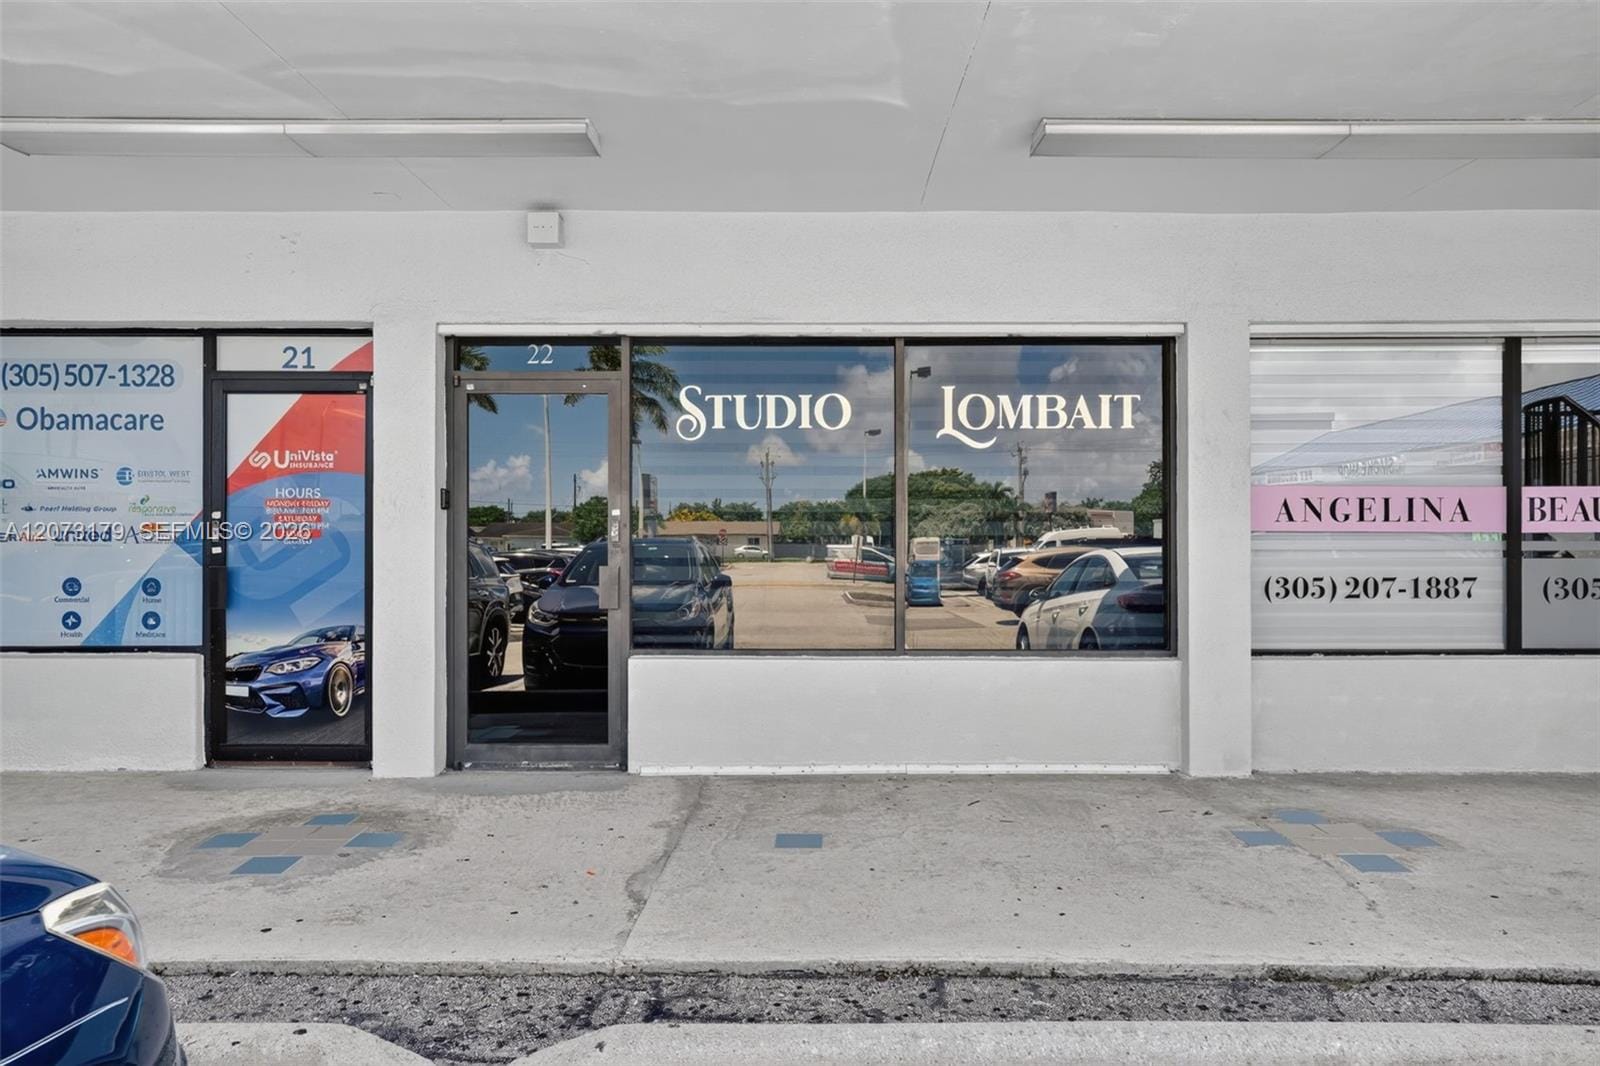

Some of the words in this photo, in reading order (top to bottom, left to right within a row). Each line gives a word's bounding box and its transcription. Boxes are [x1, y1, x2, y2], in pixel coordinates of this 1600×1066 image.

[281, 346, 315, 369] 21
[526, 344, 554, 365] 22
[1, 362, 60, 391] (305)
[64, 363, 175, 388] 507-1328
[16, 407, 165, 432] Obamacare
[273, 450, 334, 469] UniVista
[36, 468, 99, 479] AMWINS
[275, 487, 321, 498] HOURS
[1274, 497, 1472, 522] ANGELINA
[1264, 576, 1337, 603] (305)
[1344, 576, 1478, 600] 207-1887
